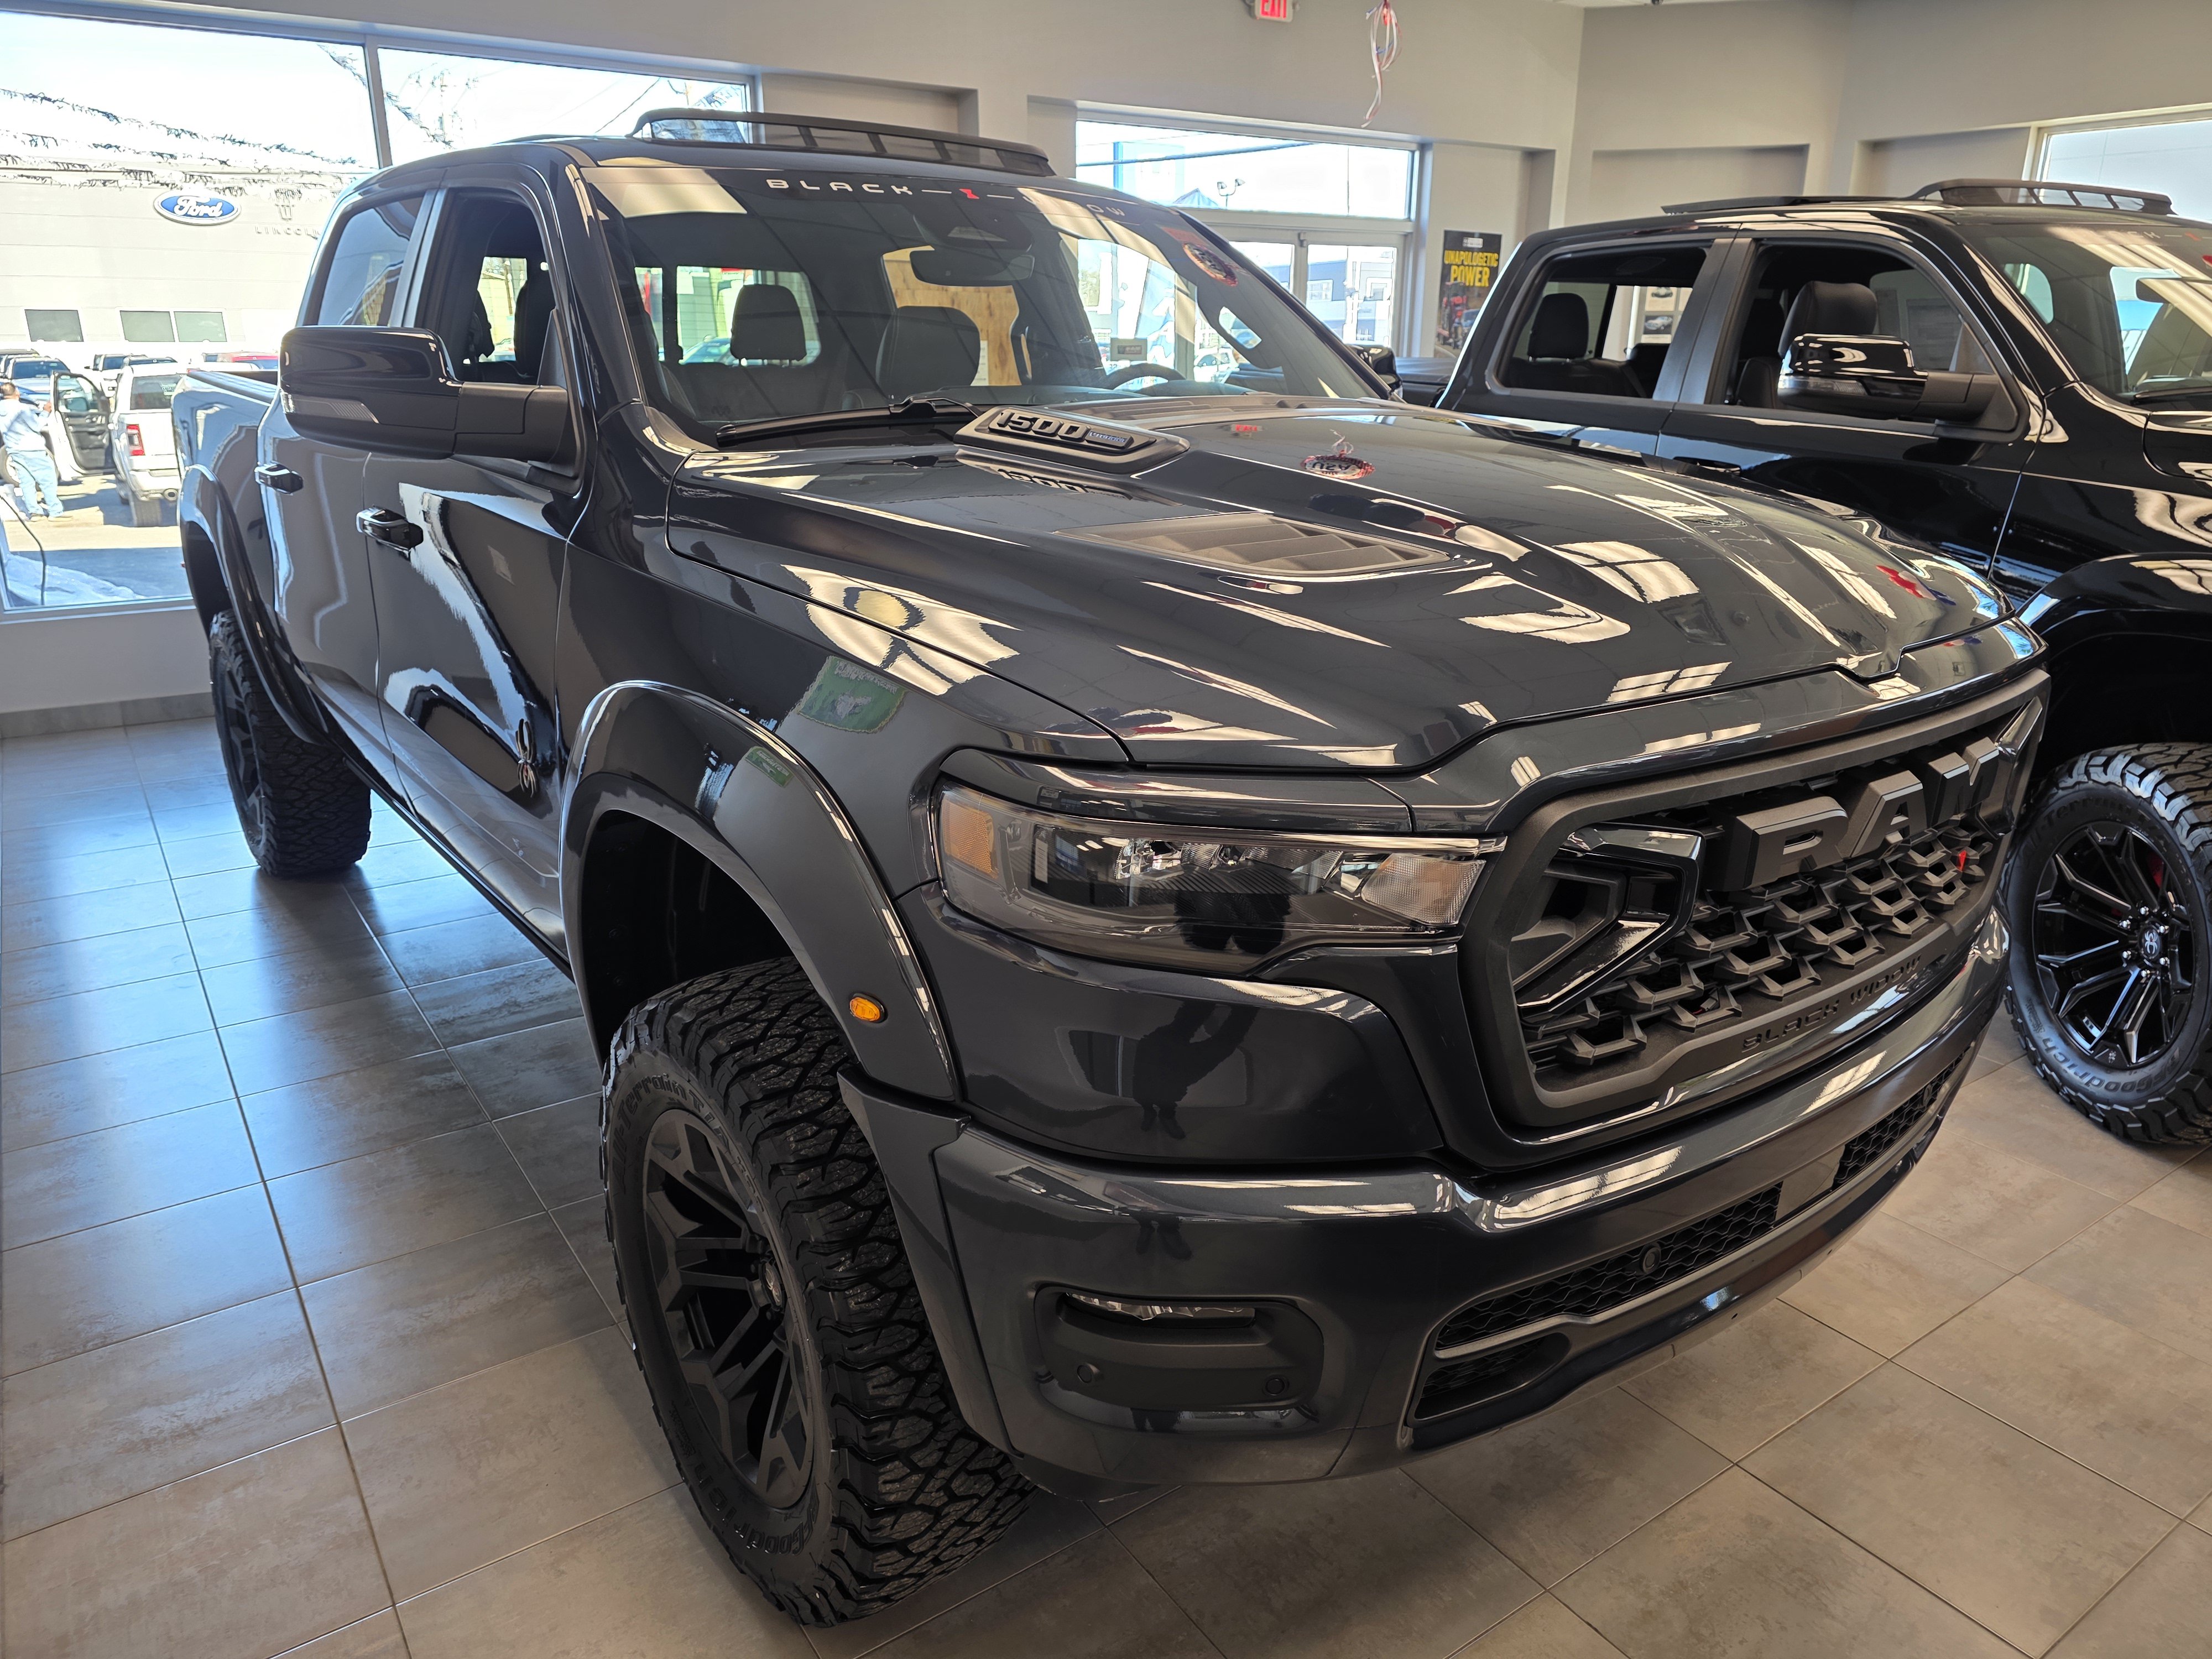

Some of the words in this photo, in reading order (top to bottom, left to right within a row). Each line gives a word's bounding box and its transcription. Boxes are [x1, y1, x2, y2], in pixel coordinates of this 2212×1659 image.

[766, 179, 913, 195] BLACK
[174, 196, 223, 217] Ford
[1450, 265, 1490, 287] POWER
[997, 411, 1091, 442] 1500
[1736, 737, 2000, 886] RAM
[1741, 1000, 1839, 1052] BLACK
[1850, 955, 1921, 1004] WIDOW
